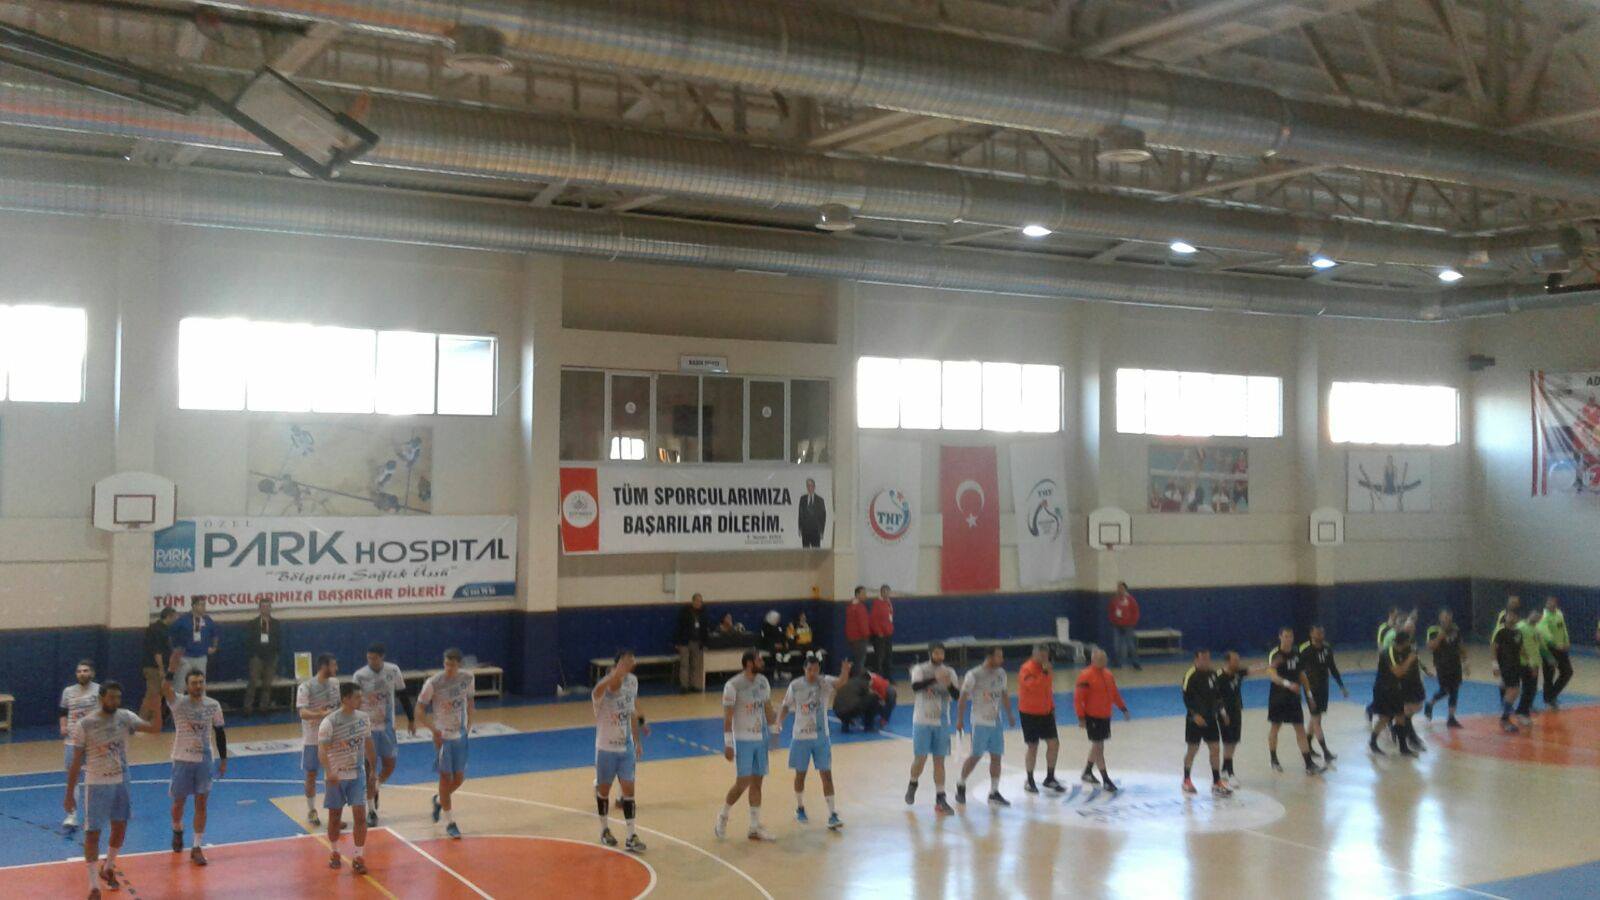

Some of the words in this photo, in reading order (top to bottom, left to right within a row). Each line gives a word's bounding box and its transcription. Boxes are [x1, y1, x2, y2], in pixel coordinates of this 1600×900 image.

[613, 483, 648, 506] TÜM
[654, 486, 792, 506] SPORCULARIMIZA
[204, 519, 252, 529] ÖZEL
[623, 515, 712, 537] BAŞARILAR
[718, 511, 784, 533] DİLERİM.
[156, 548, 192, 561] PARK
[203, 530, 348, 568] PARK
[355, 538, 510, 565] HOSPITAL
[153, 592, 185, 609] TÜM
[318, 587, 393, 603] BAŞARILAR
[397, 584, 446, 598] DİLERİZ
